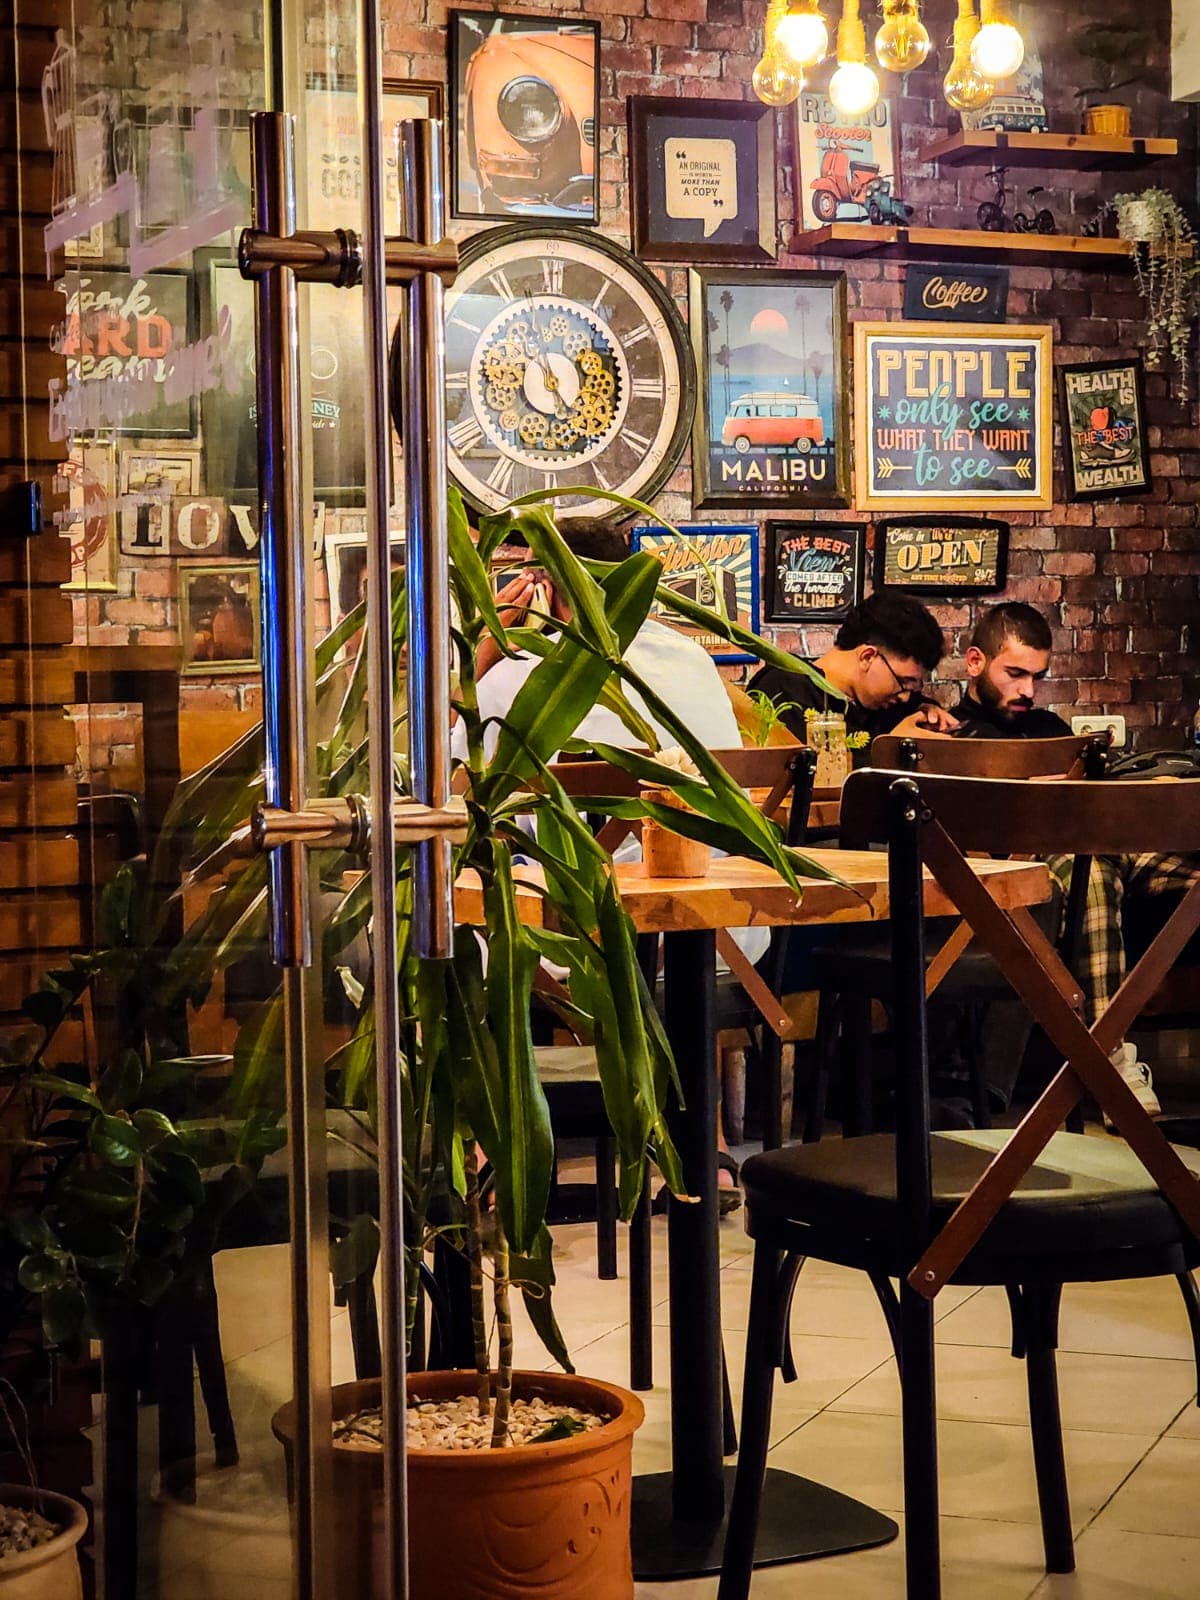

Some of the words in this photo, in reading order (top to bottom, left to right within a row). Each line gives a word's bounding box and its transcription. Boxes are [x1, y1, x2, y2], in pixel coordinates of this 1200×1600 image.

[816, 123, 872, 142] Scooter
[679, 161, 688, 170] AN
[690, 161, 721, 171] ORIGINAL
[683, 187, 690, 196] A
[692, 187, 718, 197] COPY
[922, 276, 988, 309] Coffee
[876, 350, 1031, 399] PEOPLE
[1069, 372, 1133, 394] HEALTH
[1120, 388, 1134, 405] IS
[895, 382, 964, 441] only
[968, 400, 1014, 430] see
[877, 428, 926, 450] WHAT
[932, 429, 976, 451] THEY
[981, 429, 1030, 451] WANT
[1075, 430, 1098, 445] THE
[1103, 426, 1134, 443] BEST
[721, 458, 826, 481] MALIBU
[913, 442, 944, 487] to
[950, 456, 995, 485] see
[1078, 465, 1140, 487] WEALTH
[783, 536, 810, 554] THE
[813, 537, 851, 556] BEST
[915, 530, 925, 542] in
[790, 548, 844, 572] View
[897, 539, 986, 572] OPEN
[784, 581, 801, 593] the
[794, 593, 835, 608] CLIMB
